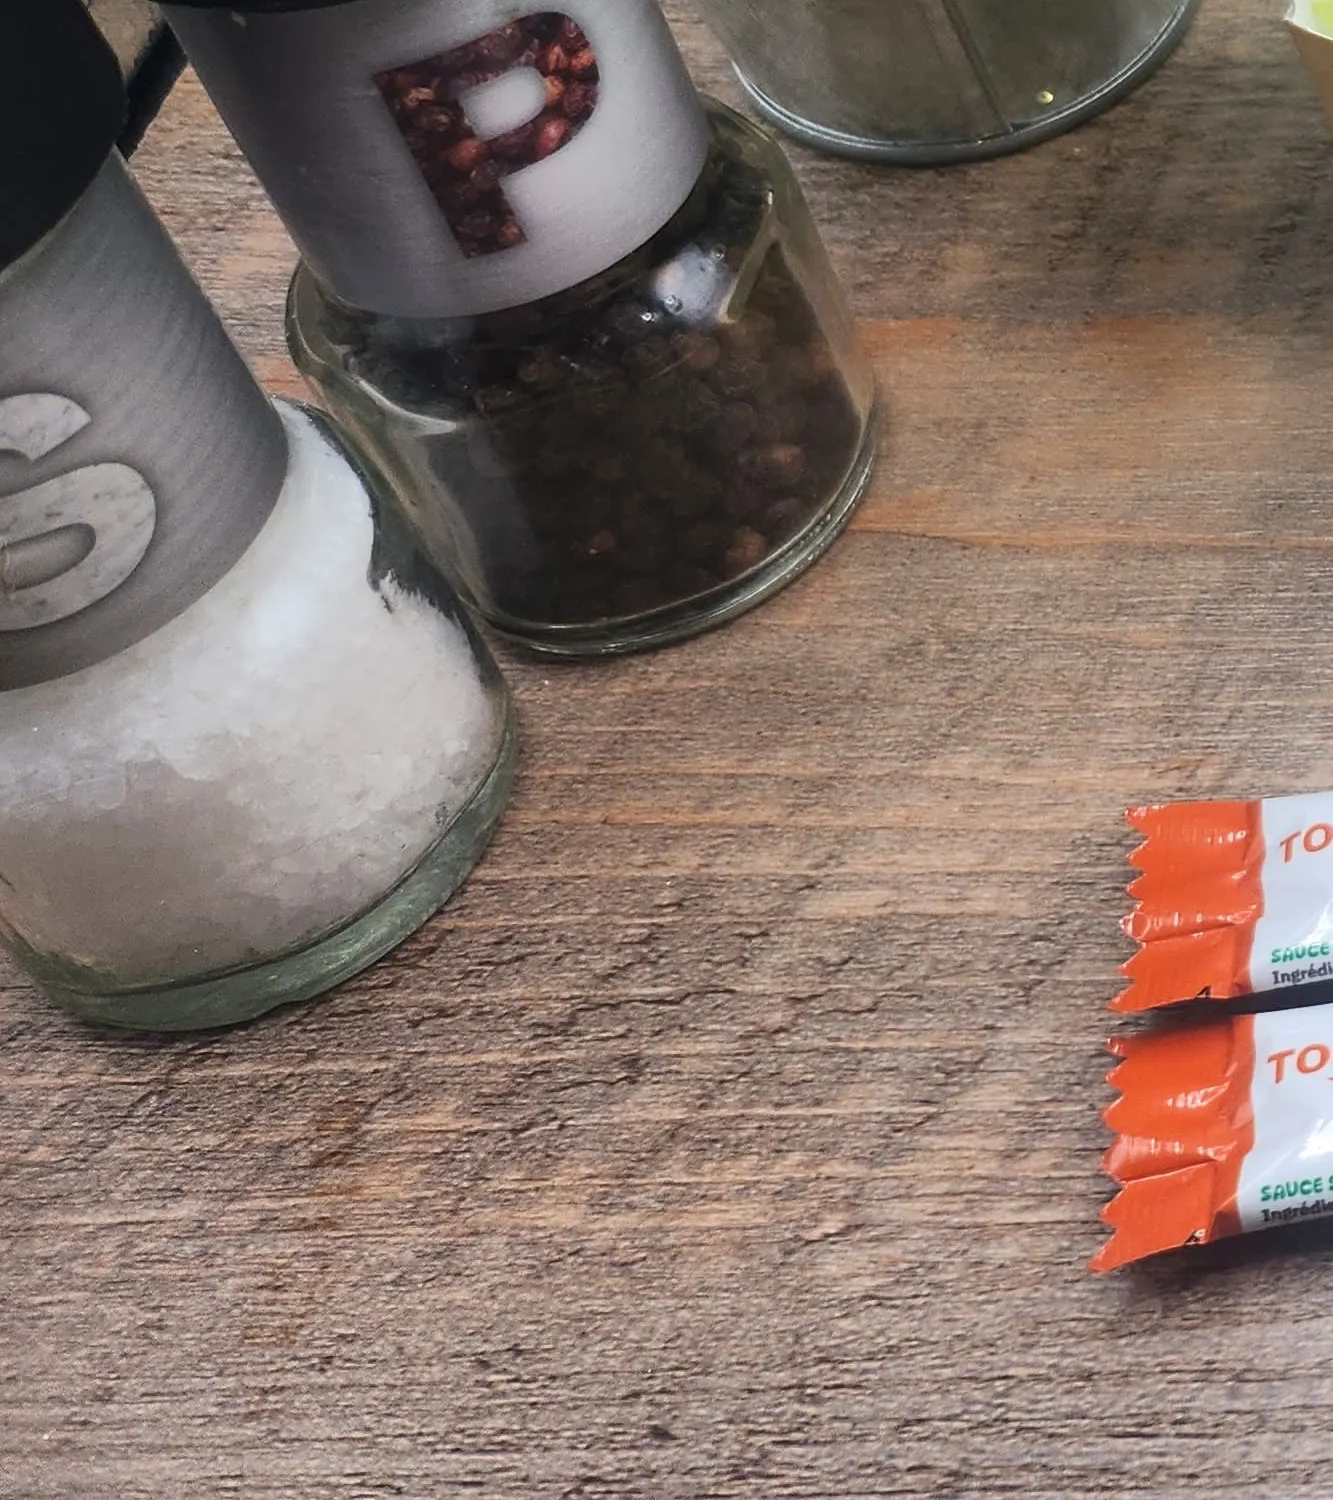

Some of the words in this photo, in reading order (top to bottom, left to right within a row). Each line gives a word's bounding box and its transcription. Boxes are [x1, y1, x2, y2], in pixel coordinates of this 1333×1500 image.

[373, 11, 599, 259] P
[1271, 944, 1330, 964] SAUCE
[1260, 1177, 1324, 1202] SAUCE
